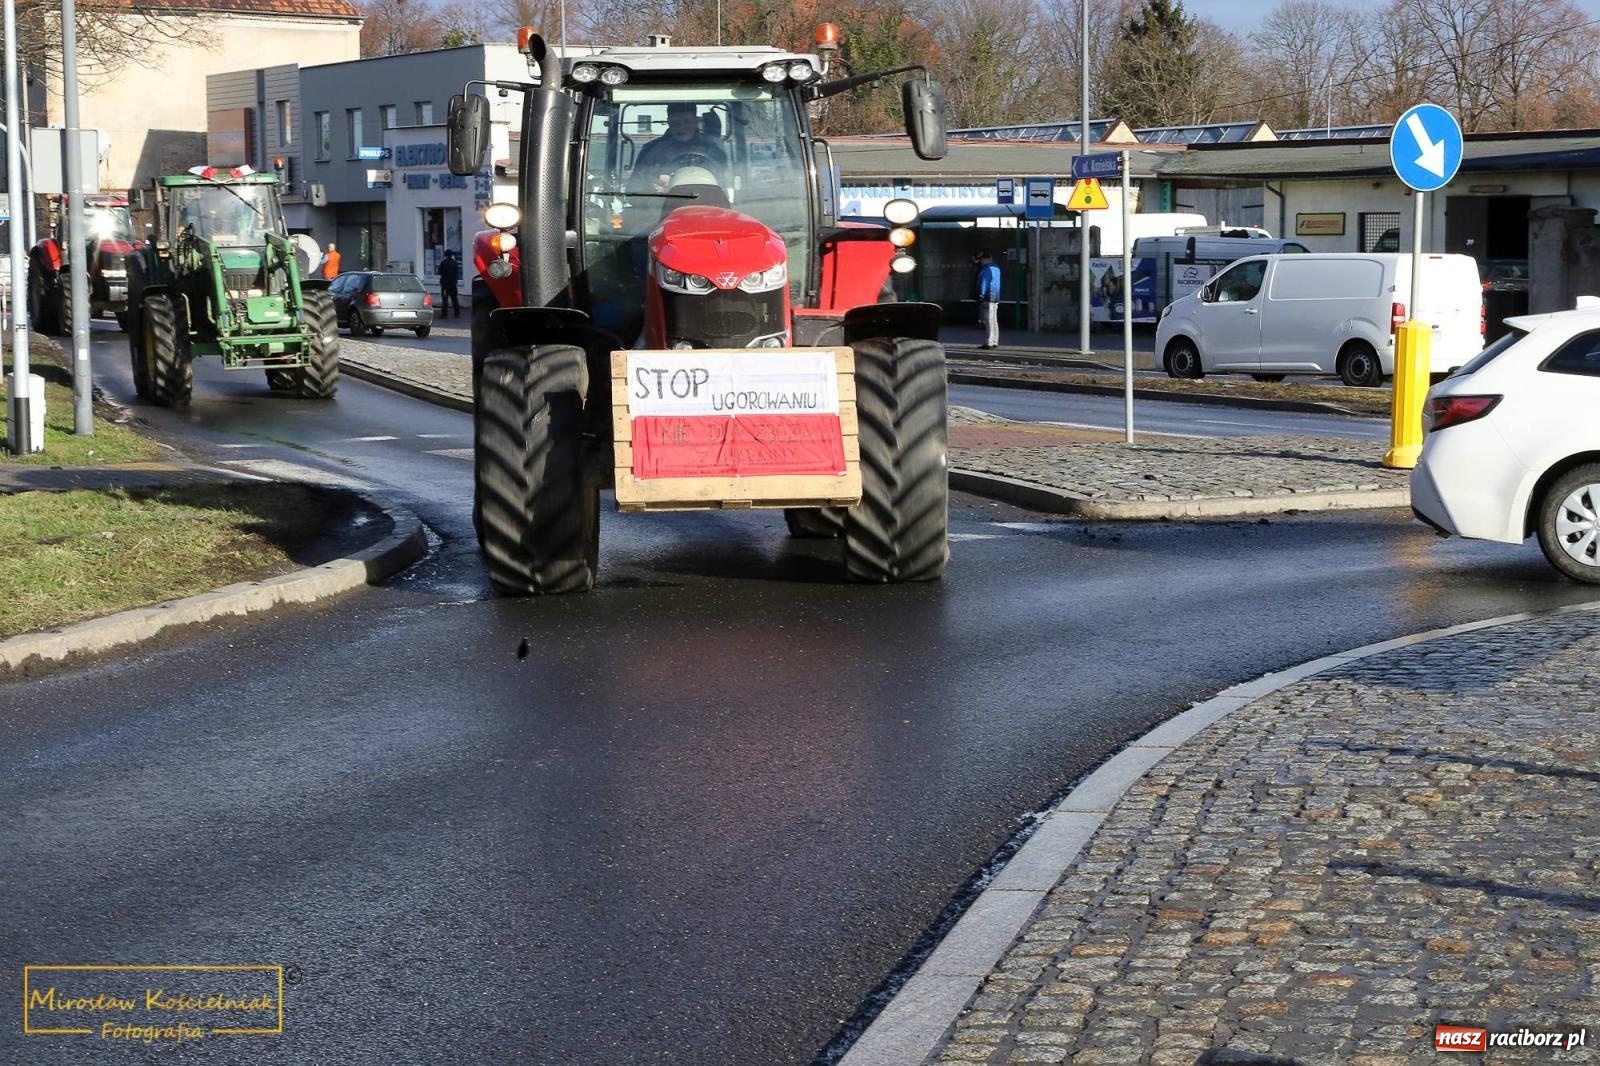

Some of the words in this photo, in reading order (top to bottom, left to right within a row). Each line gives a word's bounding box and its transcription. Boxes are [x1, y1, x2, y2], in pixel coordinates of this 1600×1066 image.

[359, 149, 390, 158] PHILIPS
[634, 367, 710, 399] STOP
[711, 391, 818, 412] UGOROWANIU
